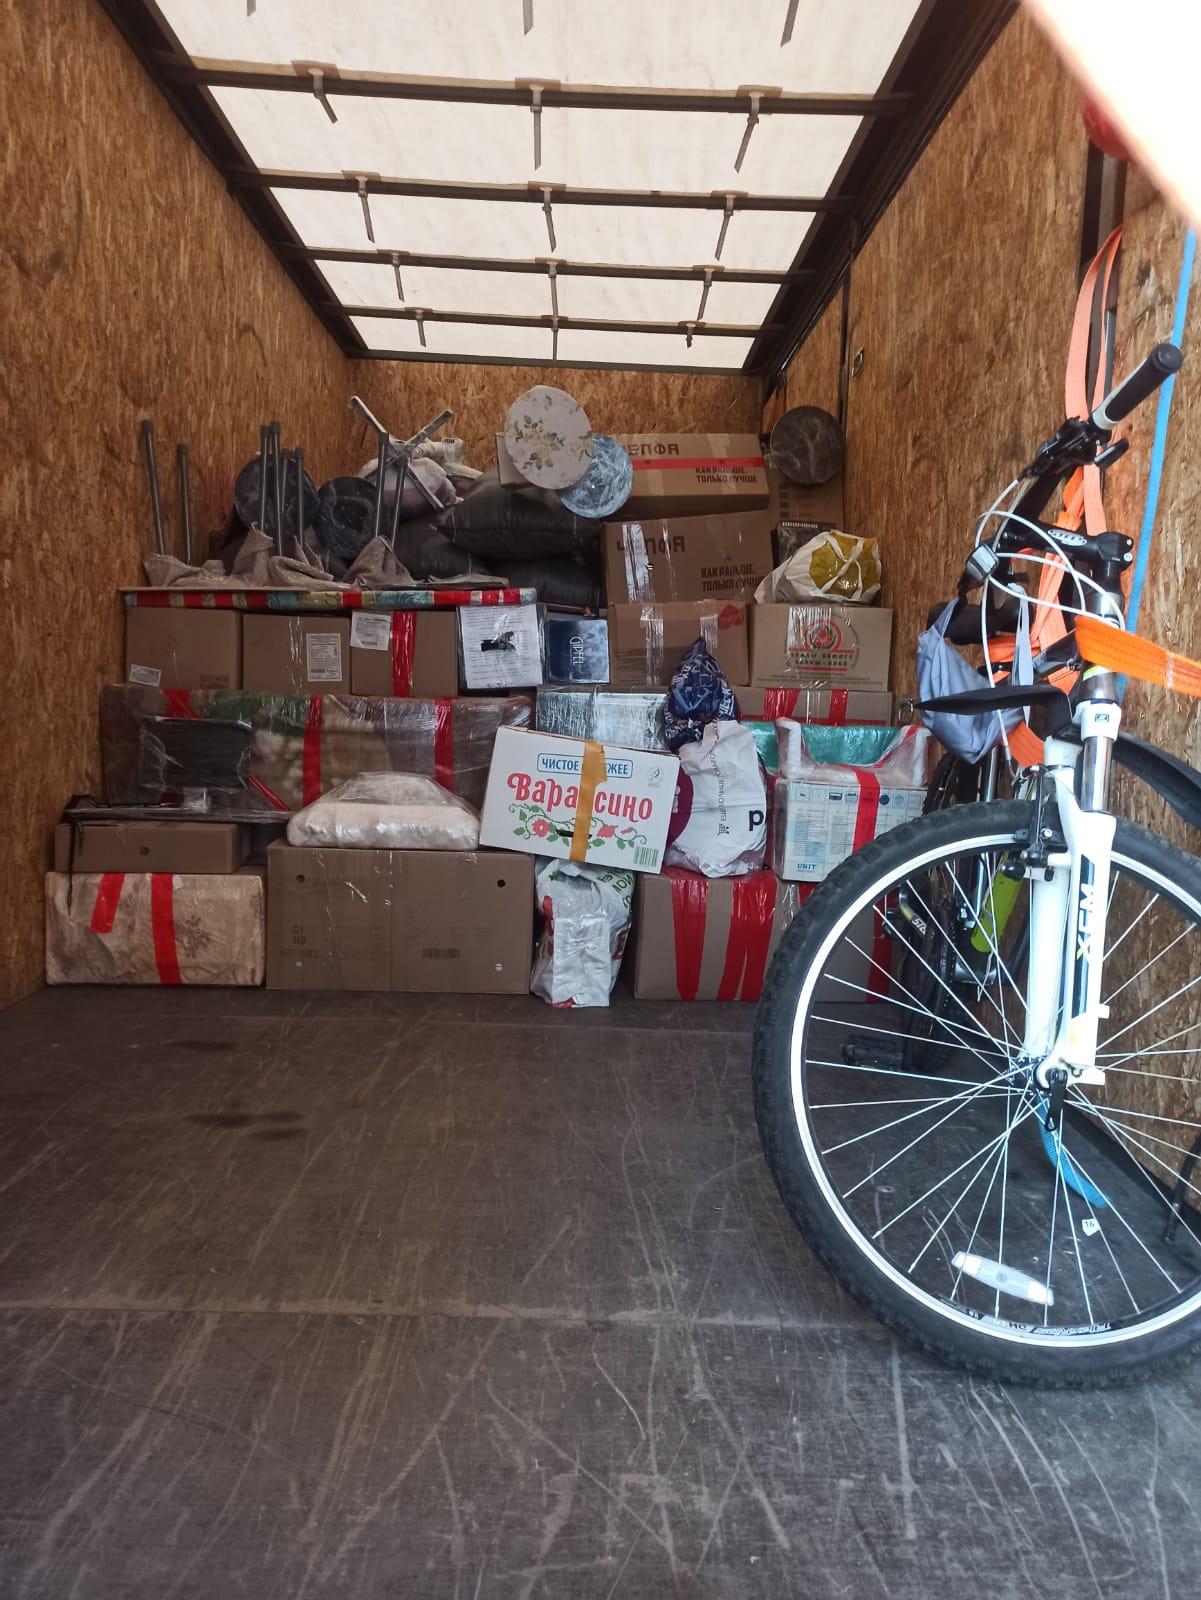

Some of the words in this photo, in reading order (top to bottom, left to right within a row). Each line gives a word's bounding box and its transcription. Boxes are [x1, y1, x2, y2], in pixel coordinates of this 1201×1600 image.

[701, 567, 718, 578] КАК
[702, 579, 734, 591] ТОЛЬКО
[542, 758, 579, 771] ЧИСТОЕ
[507, 772, 653, 822] Варасино
